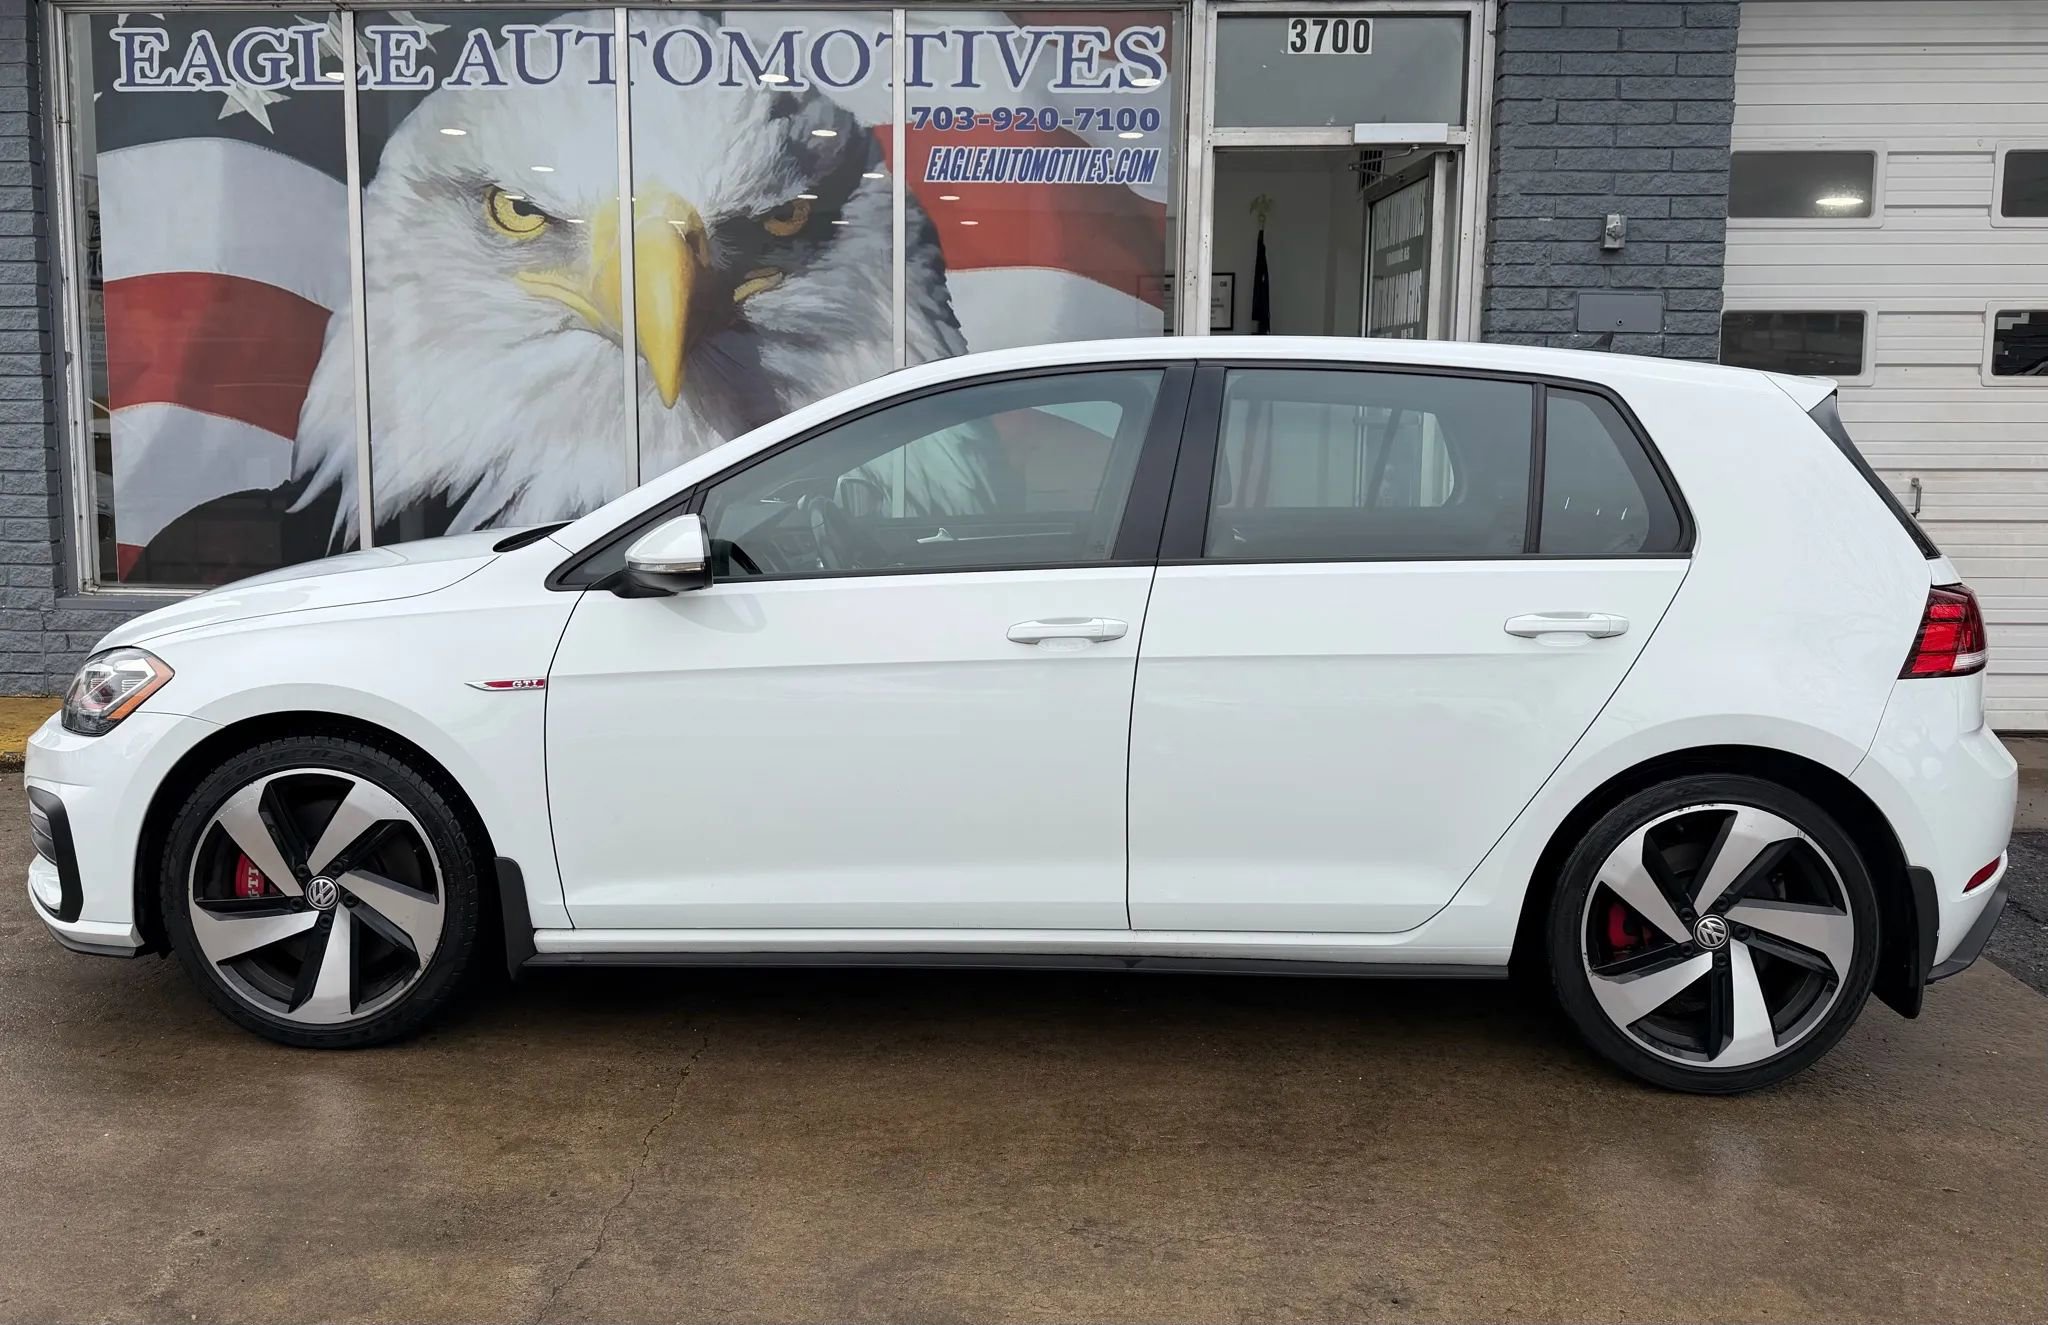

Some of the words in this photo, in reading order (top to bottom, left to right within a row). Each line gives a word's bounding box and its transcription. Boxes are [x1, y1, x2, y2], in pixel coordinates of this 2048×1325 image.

[1289, 18, 1371, 54] 3700
[111, 26, 433, 91] EAGLE
[443, 26, 1167, 92] AUTOMOTIVES
[911, 106, 1161, 132] 703-920-7100
[924, 146, 1161, 184] EAGLEAUTOMOTIVES.COM
[511, 679, 539, 689] GTI
